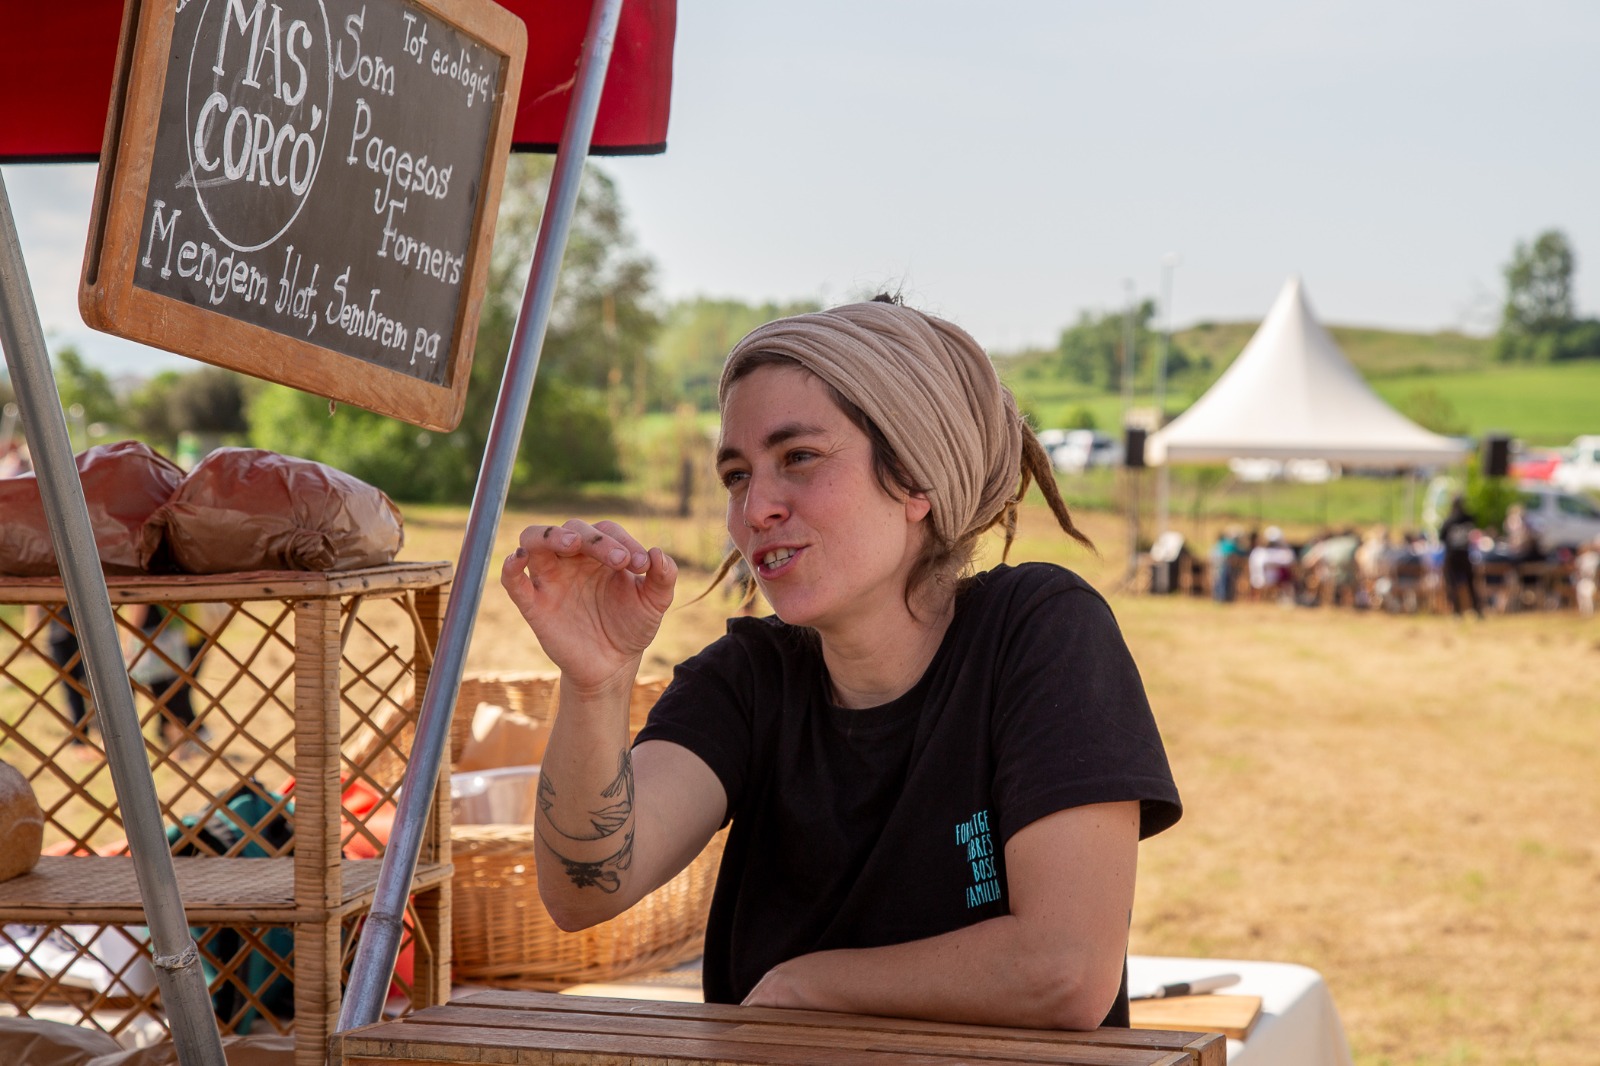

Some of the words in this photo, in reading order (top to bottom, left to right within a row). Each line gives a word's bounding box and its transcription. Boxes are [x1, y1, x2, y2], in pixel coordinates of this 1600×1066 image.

[213, 0, 313, 106] MAS
[335, 4, 394, 96] Som
[403, 11, 428, 64] Tot
[194, 92, 323, 196] CORCÓ
[347, 98, 453, 214] Pagesos
[142, 199, 269, 305] Mengem
[275, 245, 320, 336] blat,
[326, 265, 408, 351] Sembrem
[410, 327, 442, 365] pa
[377, 197, 464, 284] Forners
